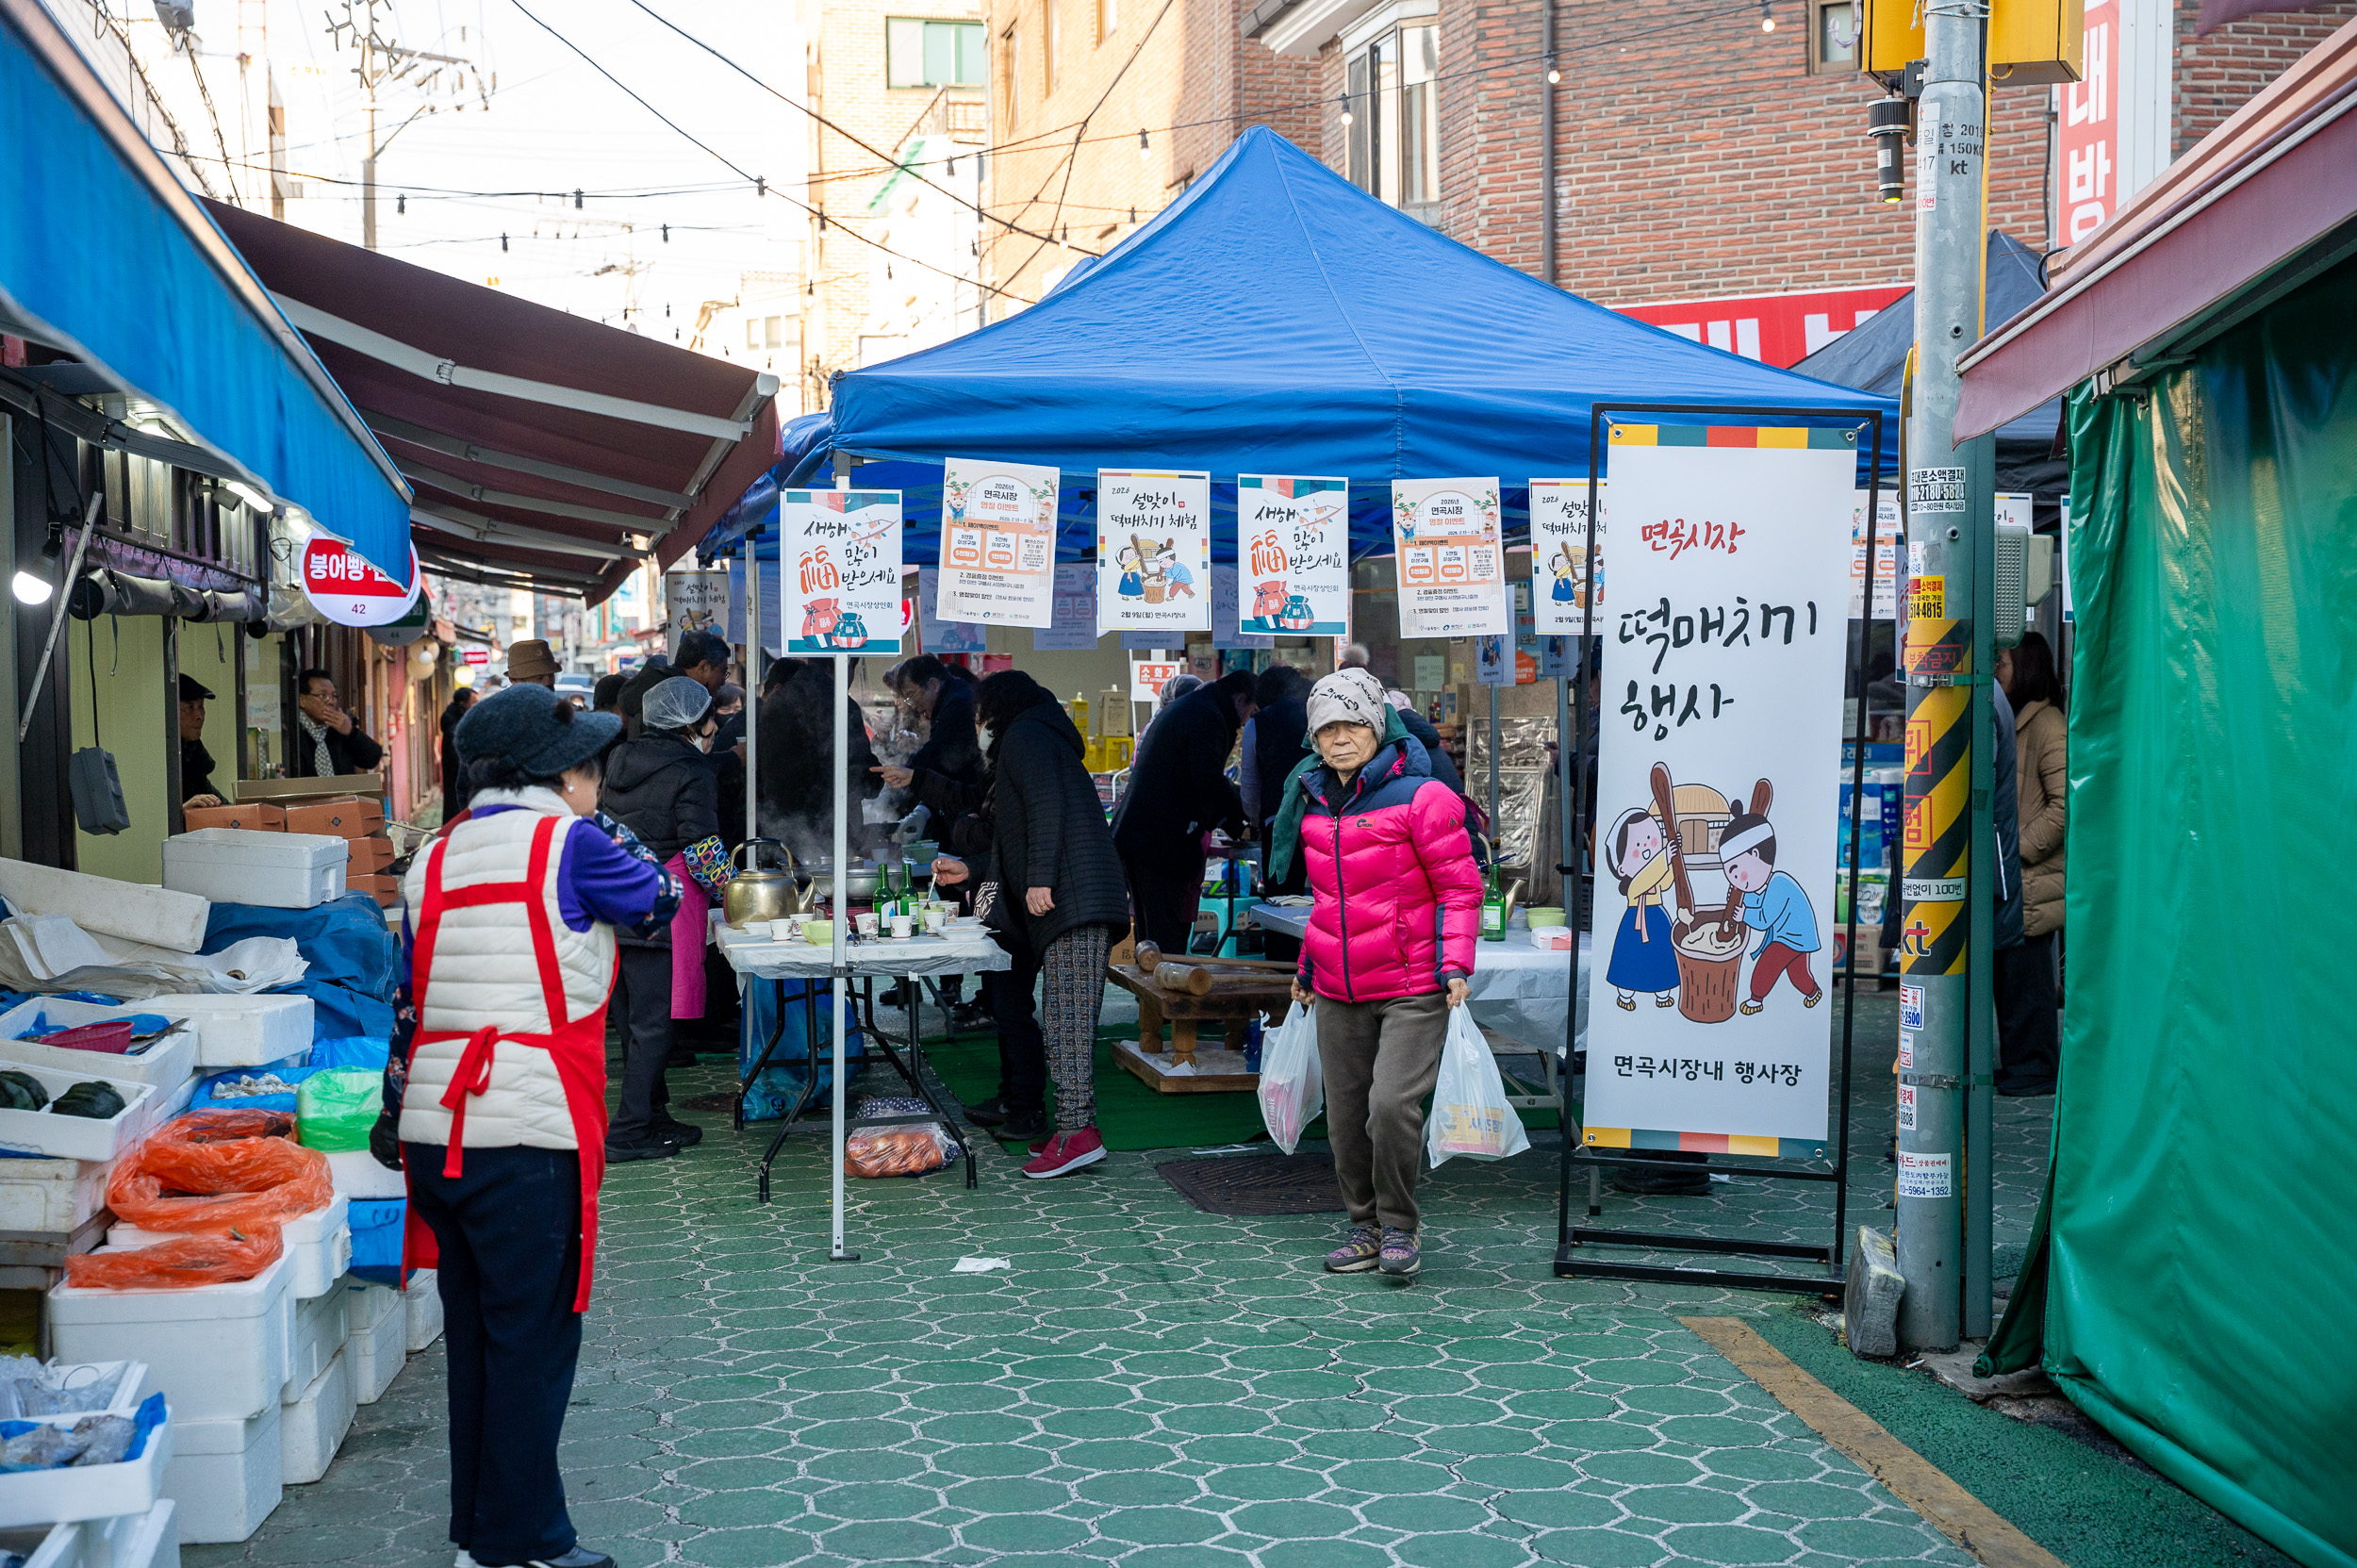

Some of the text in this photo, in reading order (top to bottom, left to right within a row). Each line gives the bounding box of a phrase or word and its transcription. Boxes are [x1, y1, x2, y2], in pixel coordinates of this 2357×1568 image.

[2068, 0, 2111, 244] 래방
[1950, 159, 1969, 175] kt
[983, 490, 1018, 501] 면곡시장
[1131, 491, 1177, 510] 설맞이
[981, 502, 1019, 512] 명절 이벤트
[1255, 505, 1296, 523] 새해
[1431, 506, 1463, 516] 면곡시장
[803, 520, 848, 537] 새해
[1110, 513, 1197, 530] 떡매치기 체험
[1294, 531, 1324, 551] 많이
[1641, 518, 1746, 560] 면곡시장
[845, 546, 878, 567] 많이
[1250, 529, 1288, 577] 福
[799, 545, 840, 594] 福
[1290, 552, 1342, 575] 받으세요
[686, 581, 713, 595] 설맞이
[842, 568, 896, 591] 받으세요
[352, 603, 366, 614] 42
[673, 594, 726, 604] 떡매치기 체험
[1618, 596, 1818, 675] 떡매치기
[1908, 651, 1956, 670] 부착금지
[1620, 679, 1735, 741] 행사
[1936, 883, 1962, 896] 100번
[1902, 916, 1931, 957] kt
[1614, 1055, 1803, 1087] 면곡시장내 행사장
